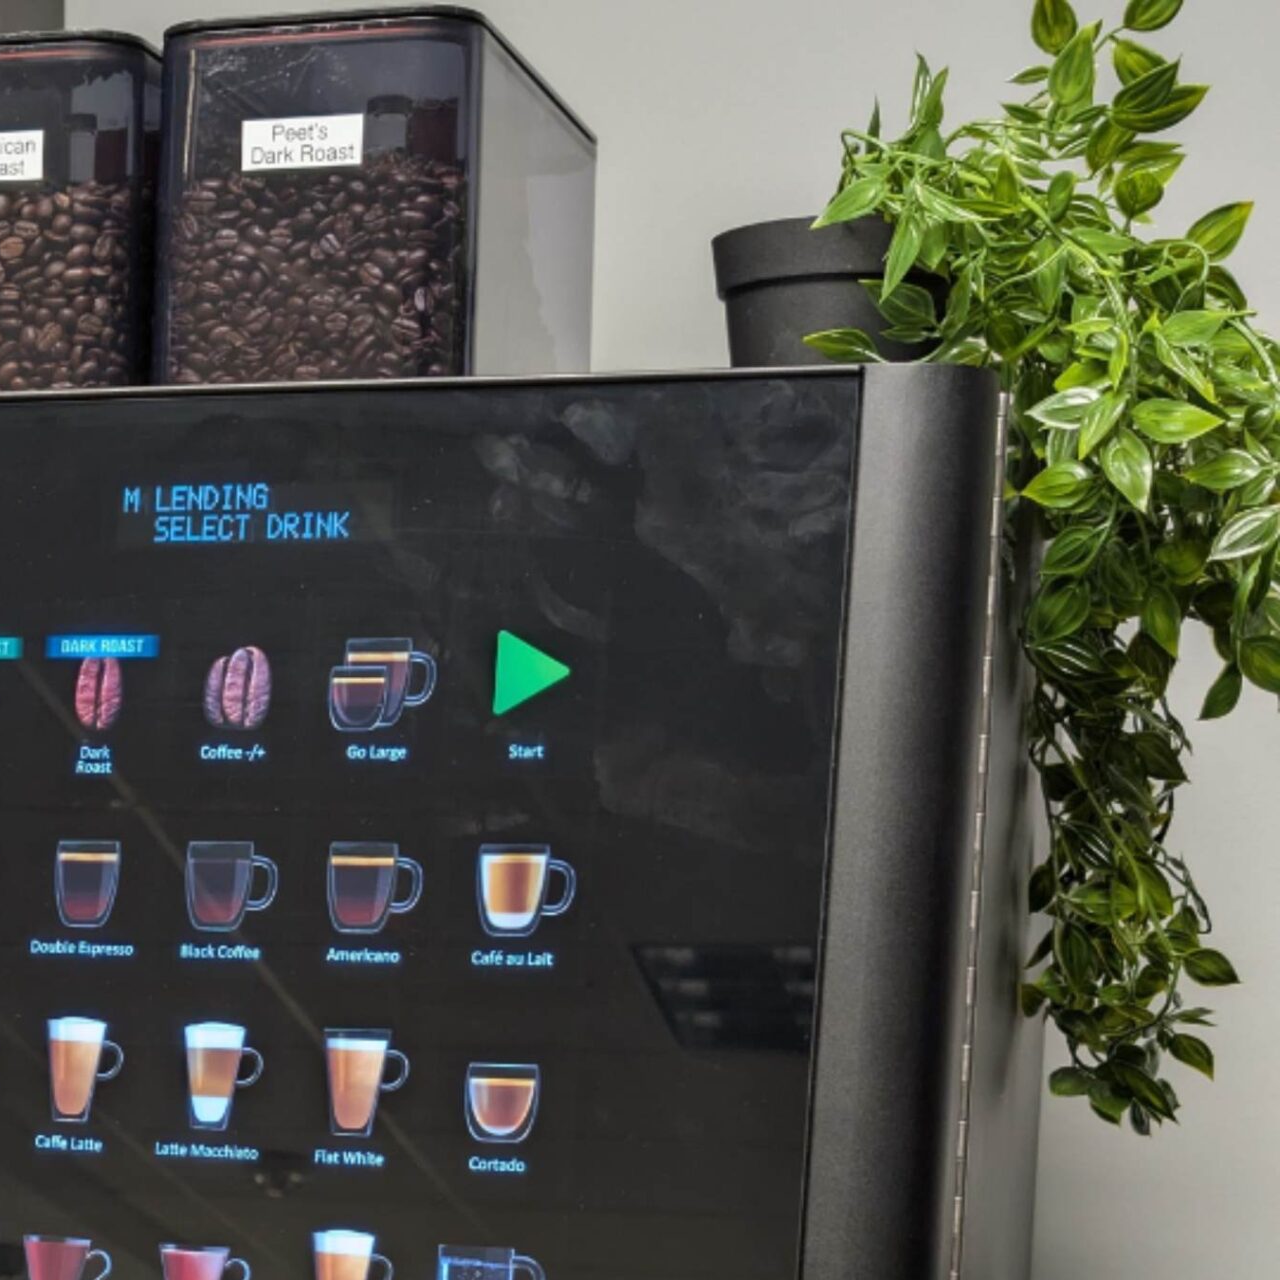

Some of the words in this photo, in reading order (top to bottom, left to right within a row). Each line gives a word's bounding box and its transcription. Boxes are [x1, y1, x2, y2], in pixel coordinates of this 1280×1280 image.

[271, 122, 329, 142] Peet's
[250, 146, 294, 165] Dark
[300, 143, 355, 162] Roast
[122, 486, 142, 513] M
[154, 482, 270, 512] LENDING
[153, 513, 251, 543] SELECT
[266, 511, 351, 540] DRINK
[60, 639, 95, 654] DARK
[100, 638, 145, 653] ROAST
[79, 745, 111, 760] Dark
[199, 744, 243, 760] Coffee
[346, 745, 368, 760] Go
[369, 745, 409, 762] Large
[507, 744, 545, 760] Start
[75, 760, 113, 774] Roast
[30, 939, 77, 956] Double
[78, 941, 135, 959] Espresso
[179, 943, 216, 960] Black
[217, 945, 262, 962] Coffee
[325, 947, 401, 964] Americano
[471, 950, 504, 966] Café
[504, 954, 524, 966] au
[526, 951, 554, 967] Lait
[70, 1136, 104, 1152] Latte
[154, 1140, 189, 1157] Latte
[189, 1142, 259, 1161] Macchiato
[314, 1148, 342, 1165] Flat
[342, 1150, 385, 1167] White
[467, 1156, 526, 1174] Cortado
